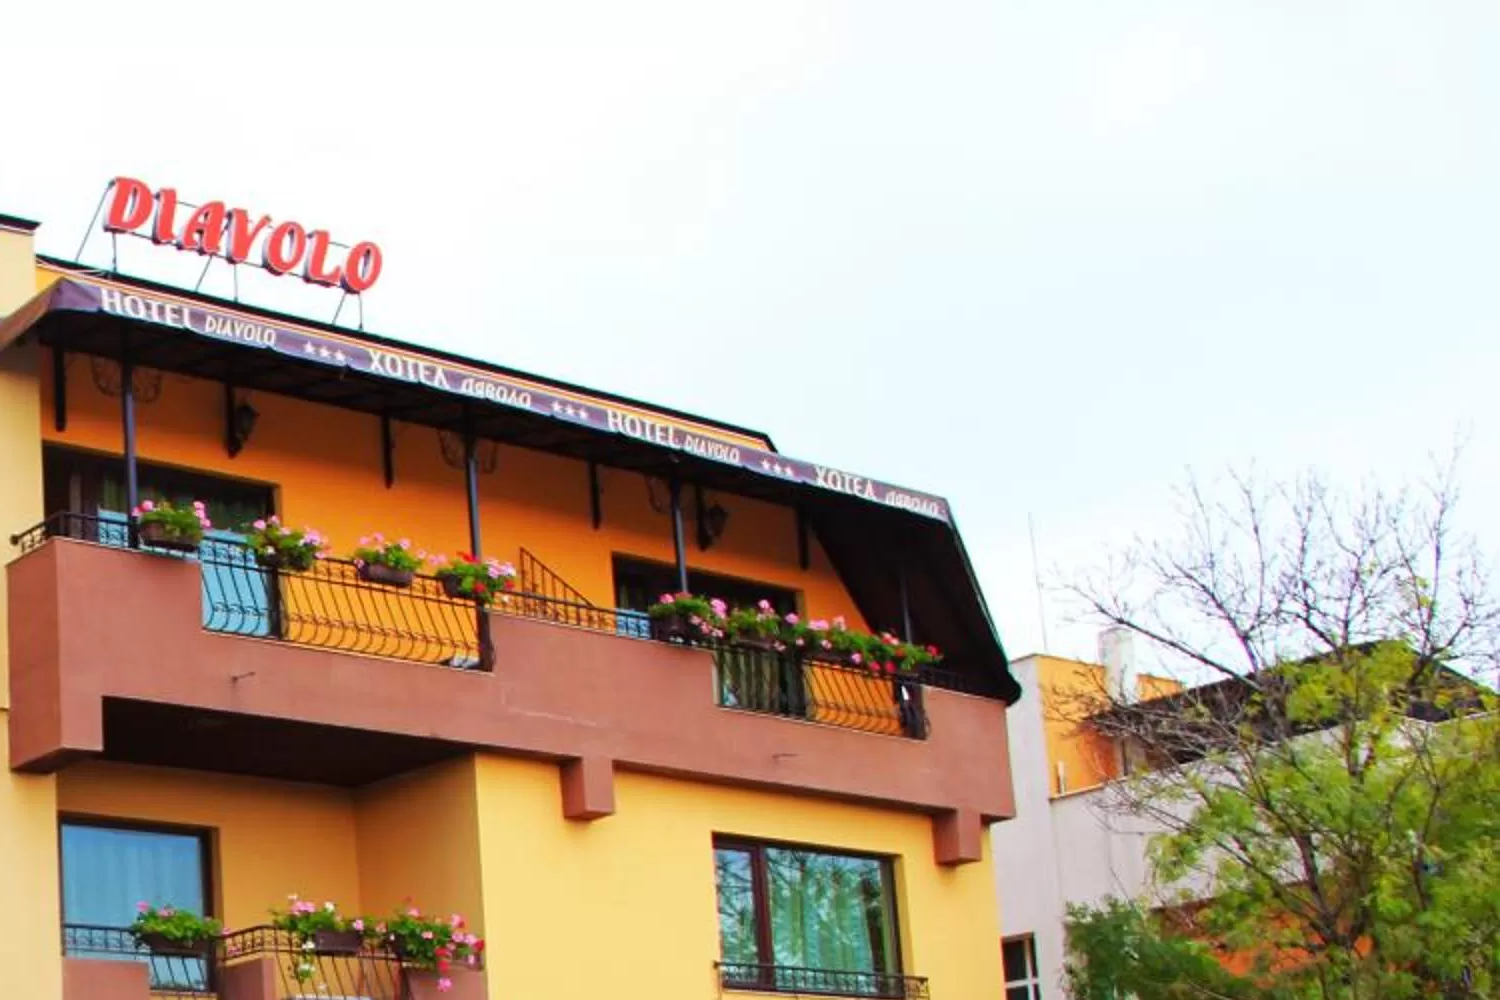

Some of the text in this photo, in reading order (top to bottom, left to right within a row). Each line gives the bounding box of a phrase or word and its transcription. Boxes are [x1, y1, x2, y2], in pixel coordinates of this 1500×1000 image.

[104, 176, 382, 294] DIAVOLO
[101, 287, 277, 345] HOTEL DIAVOLO
[367, 348, 450, 390] ХОТЕЛ
[607, 408, 740, 463] HOTEL DIAVOLO
[813, 464, 877, 501] ХОТЕЛ
